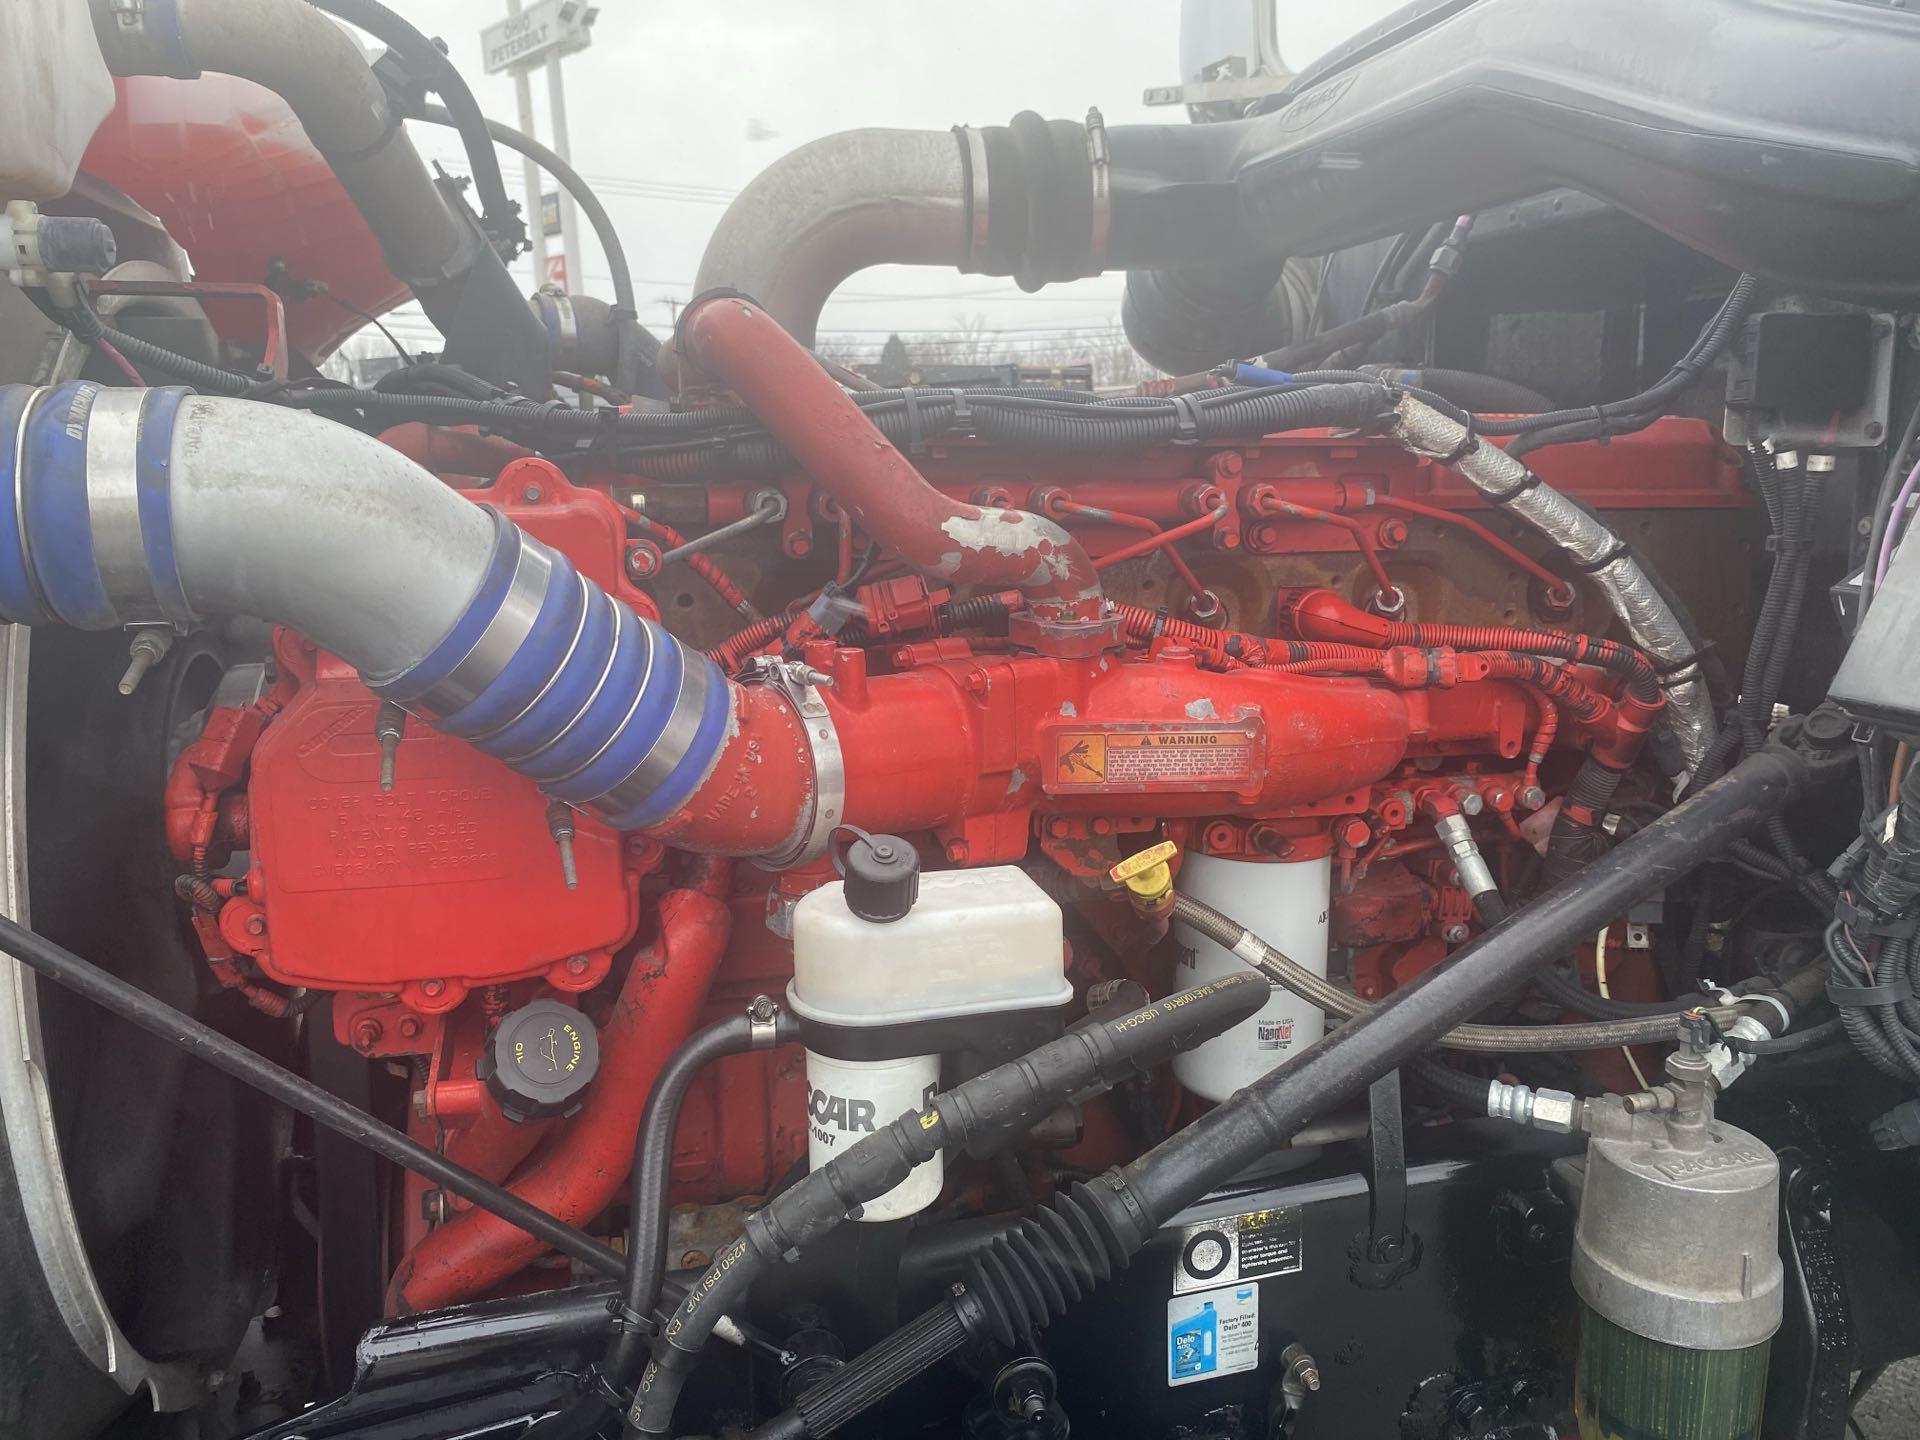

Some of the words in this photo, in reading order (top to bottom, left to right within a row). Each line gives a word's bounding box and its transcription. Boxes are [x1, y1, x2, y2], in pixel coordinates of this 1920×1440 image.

[504, 13, 530, 40] OHIO
[491, 24, 548, 66] PETERBILT
[1158, 735, 1217, 745] WARNING
[430, 786, 493, 803] TORQUE
[703, 784, 740, 822] MADE
[1163, 986, 1215, 1011] SAE100R16
[1115, 1008, 1160, 1034] USCG-H
[1258, 1024, 1292, 1041] NanoNet
[515, 1042, 525, 1064] OIL
[563, 1024, 581, 1072] ENGINE
[721, 1239, 747, 1271] 4250
[1260, 1250, 1277, 1260] torque
[702, 1267, 721, 1292] PSI
[686, 1290, 703, 1314] WP
[1220, 1316, 1239, 1326] Factory
[1241, 1320, 1252, 1329] 400
[1176, 1335, 1195, 1346] Delo
